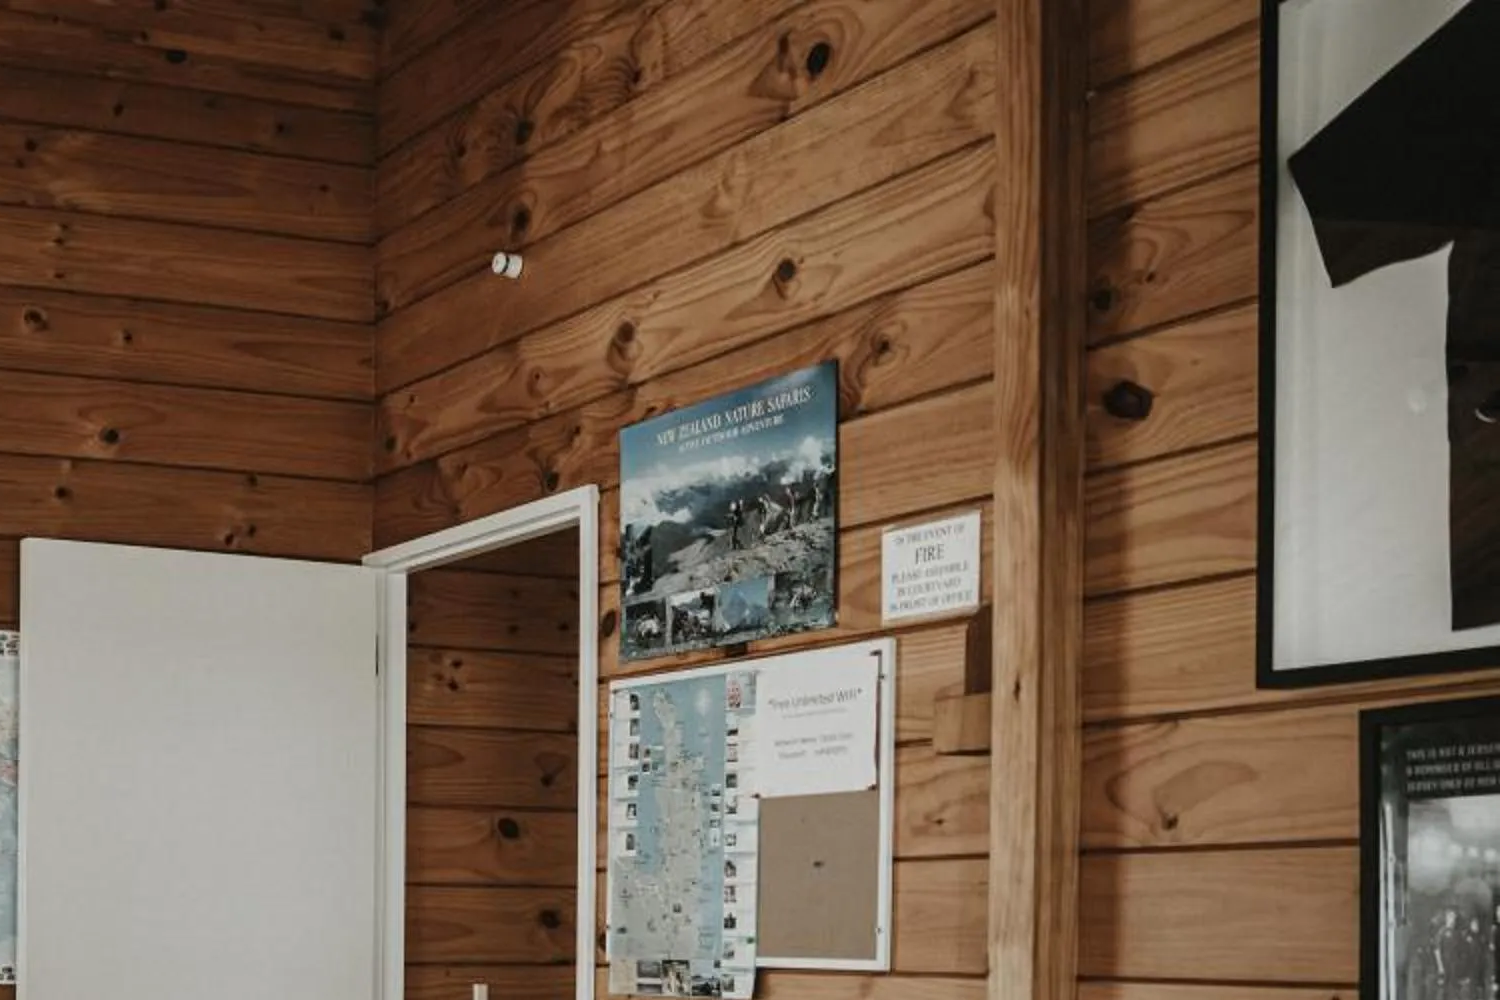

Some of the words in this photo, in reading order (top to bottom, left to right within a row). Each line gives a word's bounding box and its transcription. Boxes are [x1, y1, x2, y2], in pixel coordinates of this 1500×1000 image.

[656, 428, 675, 446] NEW
[678, 414, 721, 438] ZEALAND
[724, 402, 765, 424] NATURE
[767, 386, 812, 413] SAFARIS
[915, 543, 945, 565] FIRE
